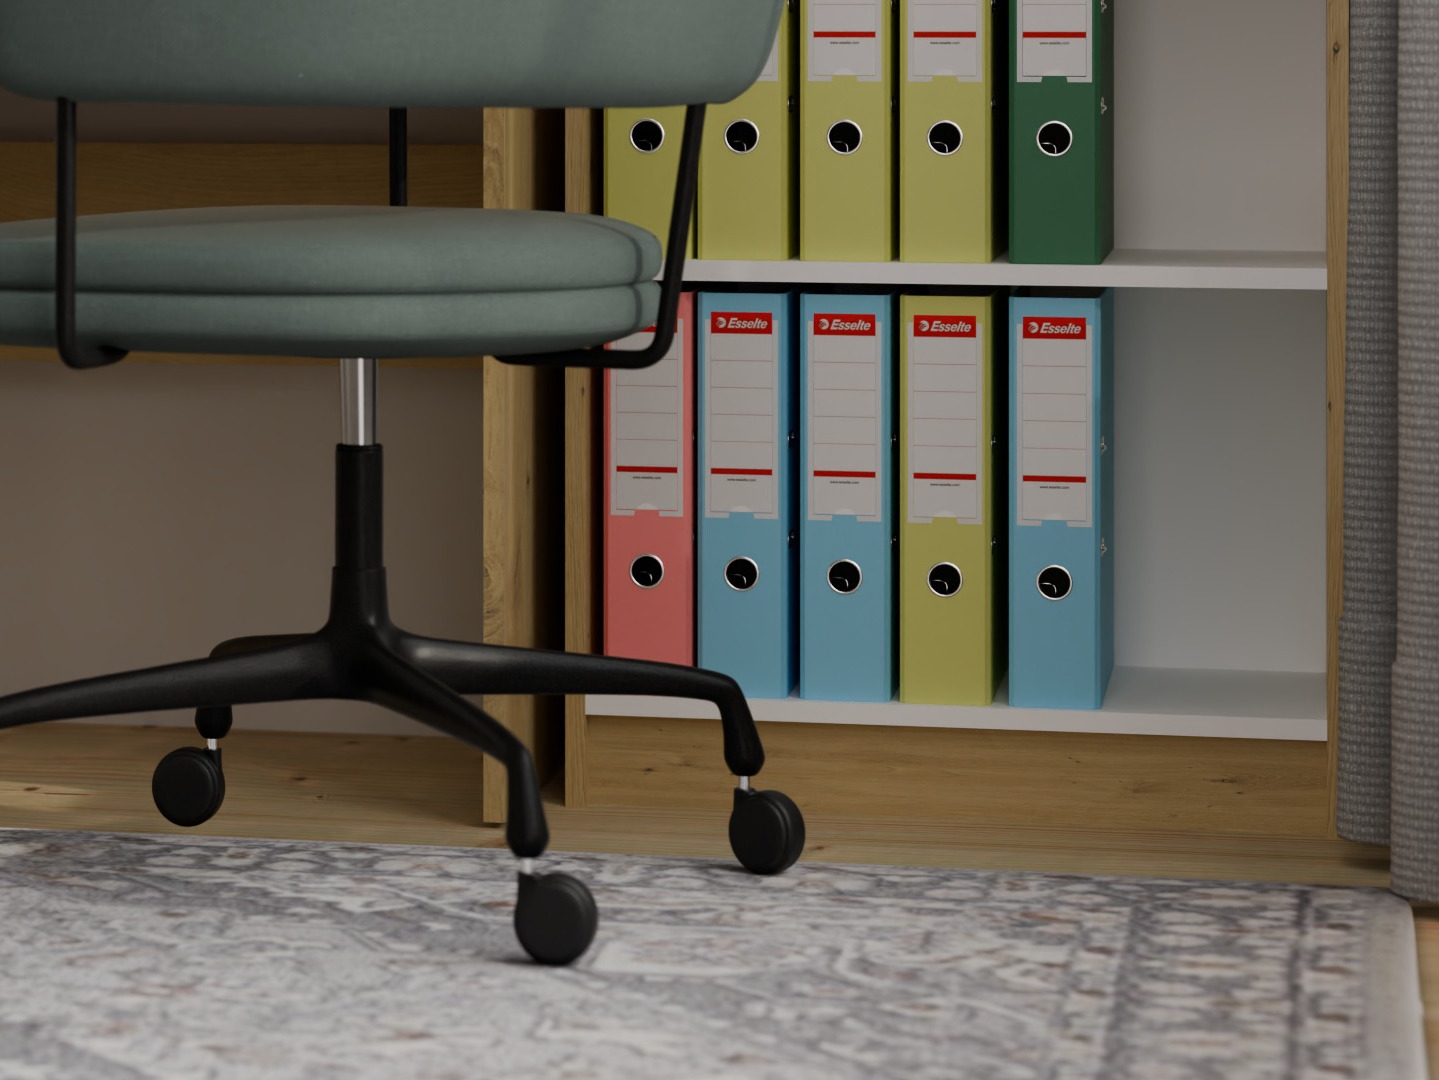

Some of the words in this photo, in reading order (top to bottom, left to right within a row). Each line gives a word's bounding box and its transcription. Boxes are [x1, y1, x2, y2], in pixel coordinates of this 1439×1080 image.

[728, 318, 767, 328] Esselte
[831, 319, 871, 330] Esselte
[931, 321, 971, 332] Esselte
[1040, 323, 1081, 333] Esselte
